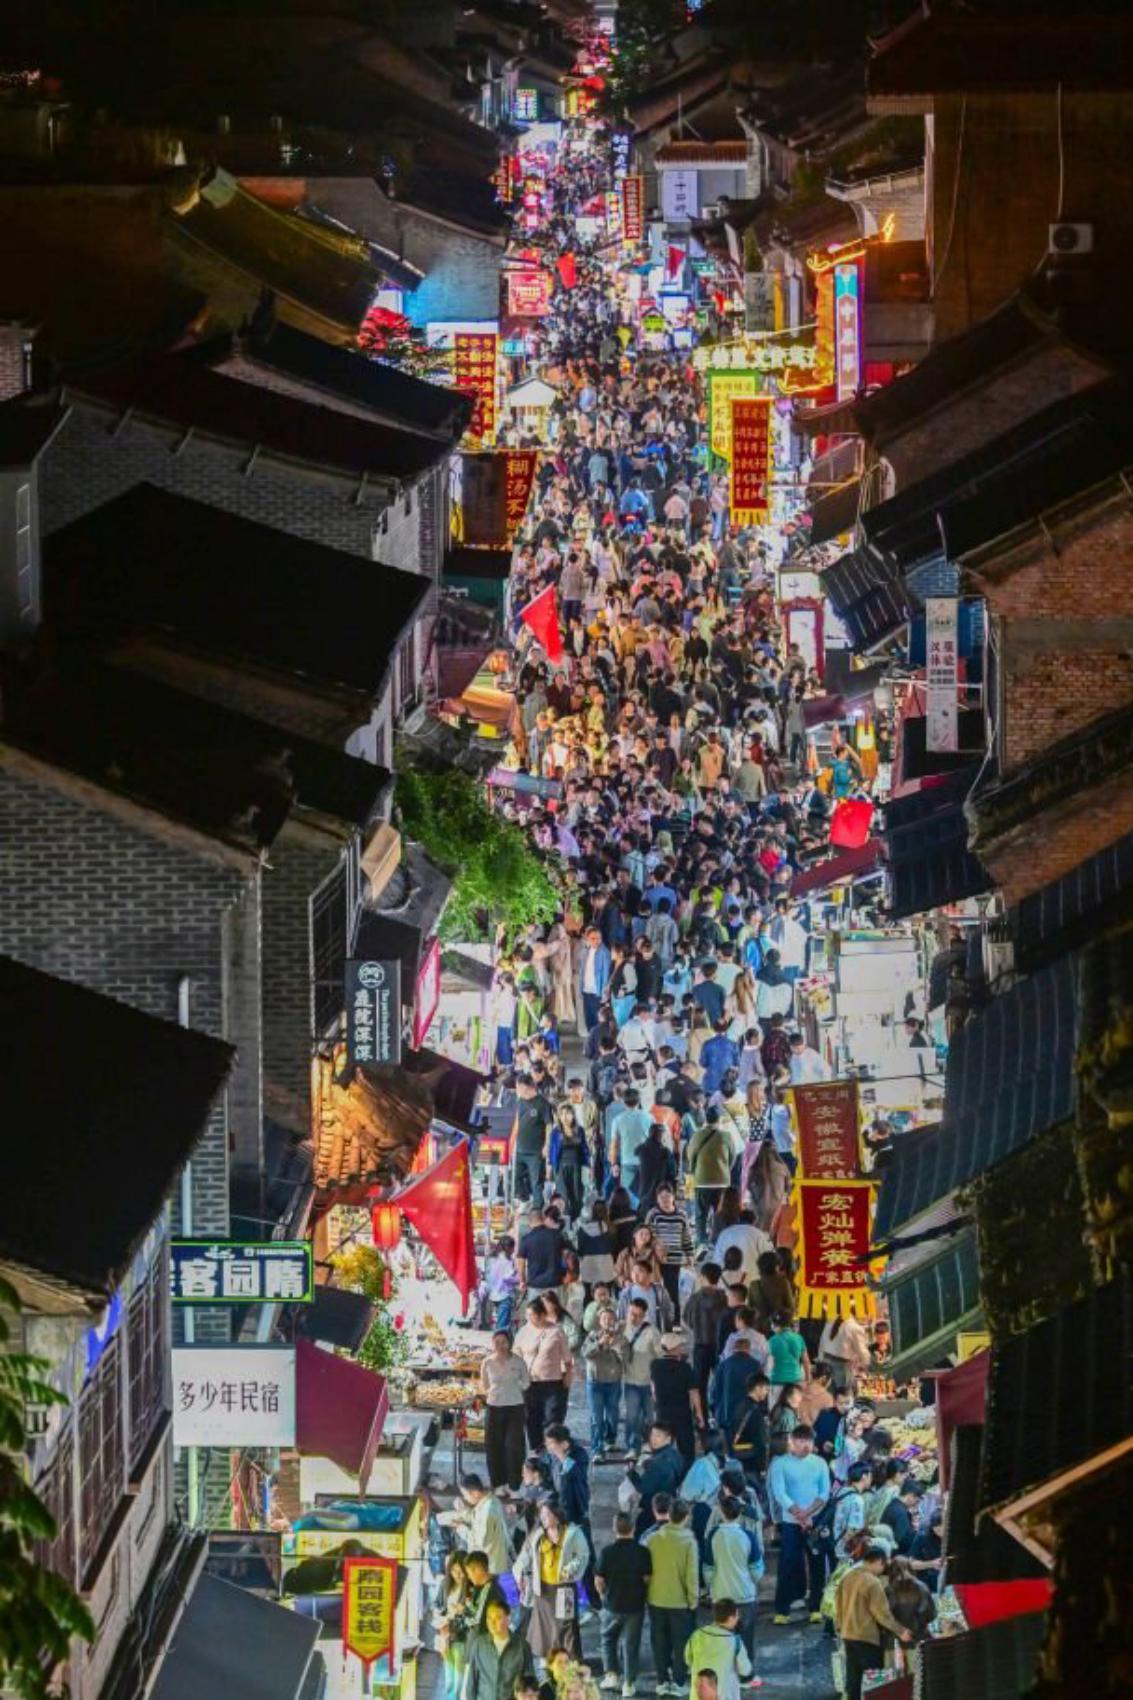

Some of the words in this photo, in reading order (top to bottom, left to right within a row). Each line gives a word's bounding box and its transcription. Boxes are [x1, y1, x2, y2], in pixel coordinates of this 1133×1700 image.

[179, 1381, 279, 1413] 多少年民宿
